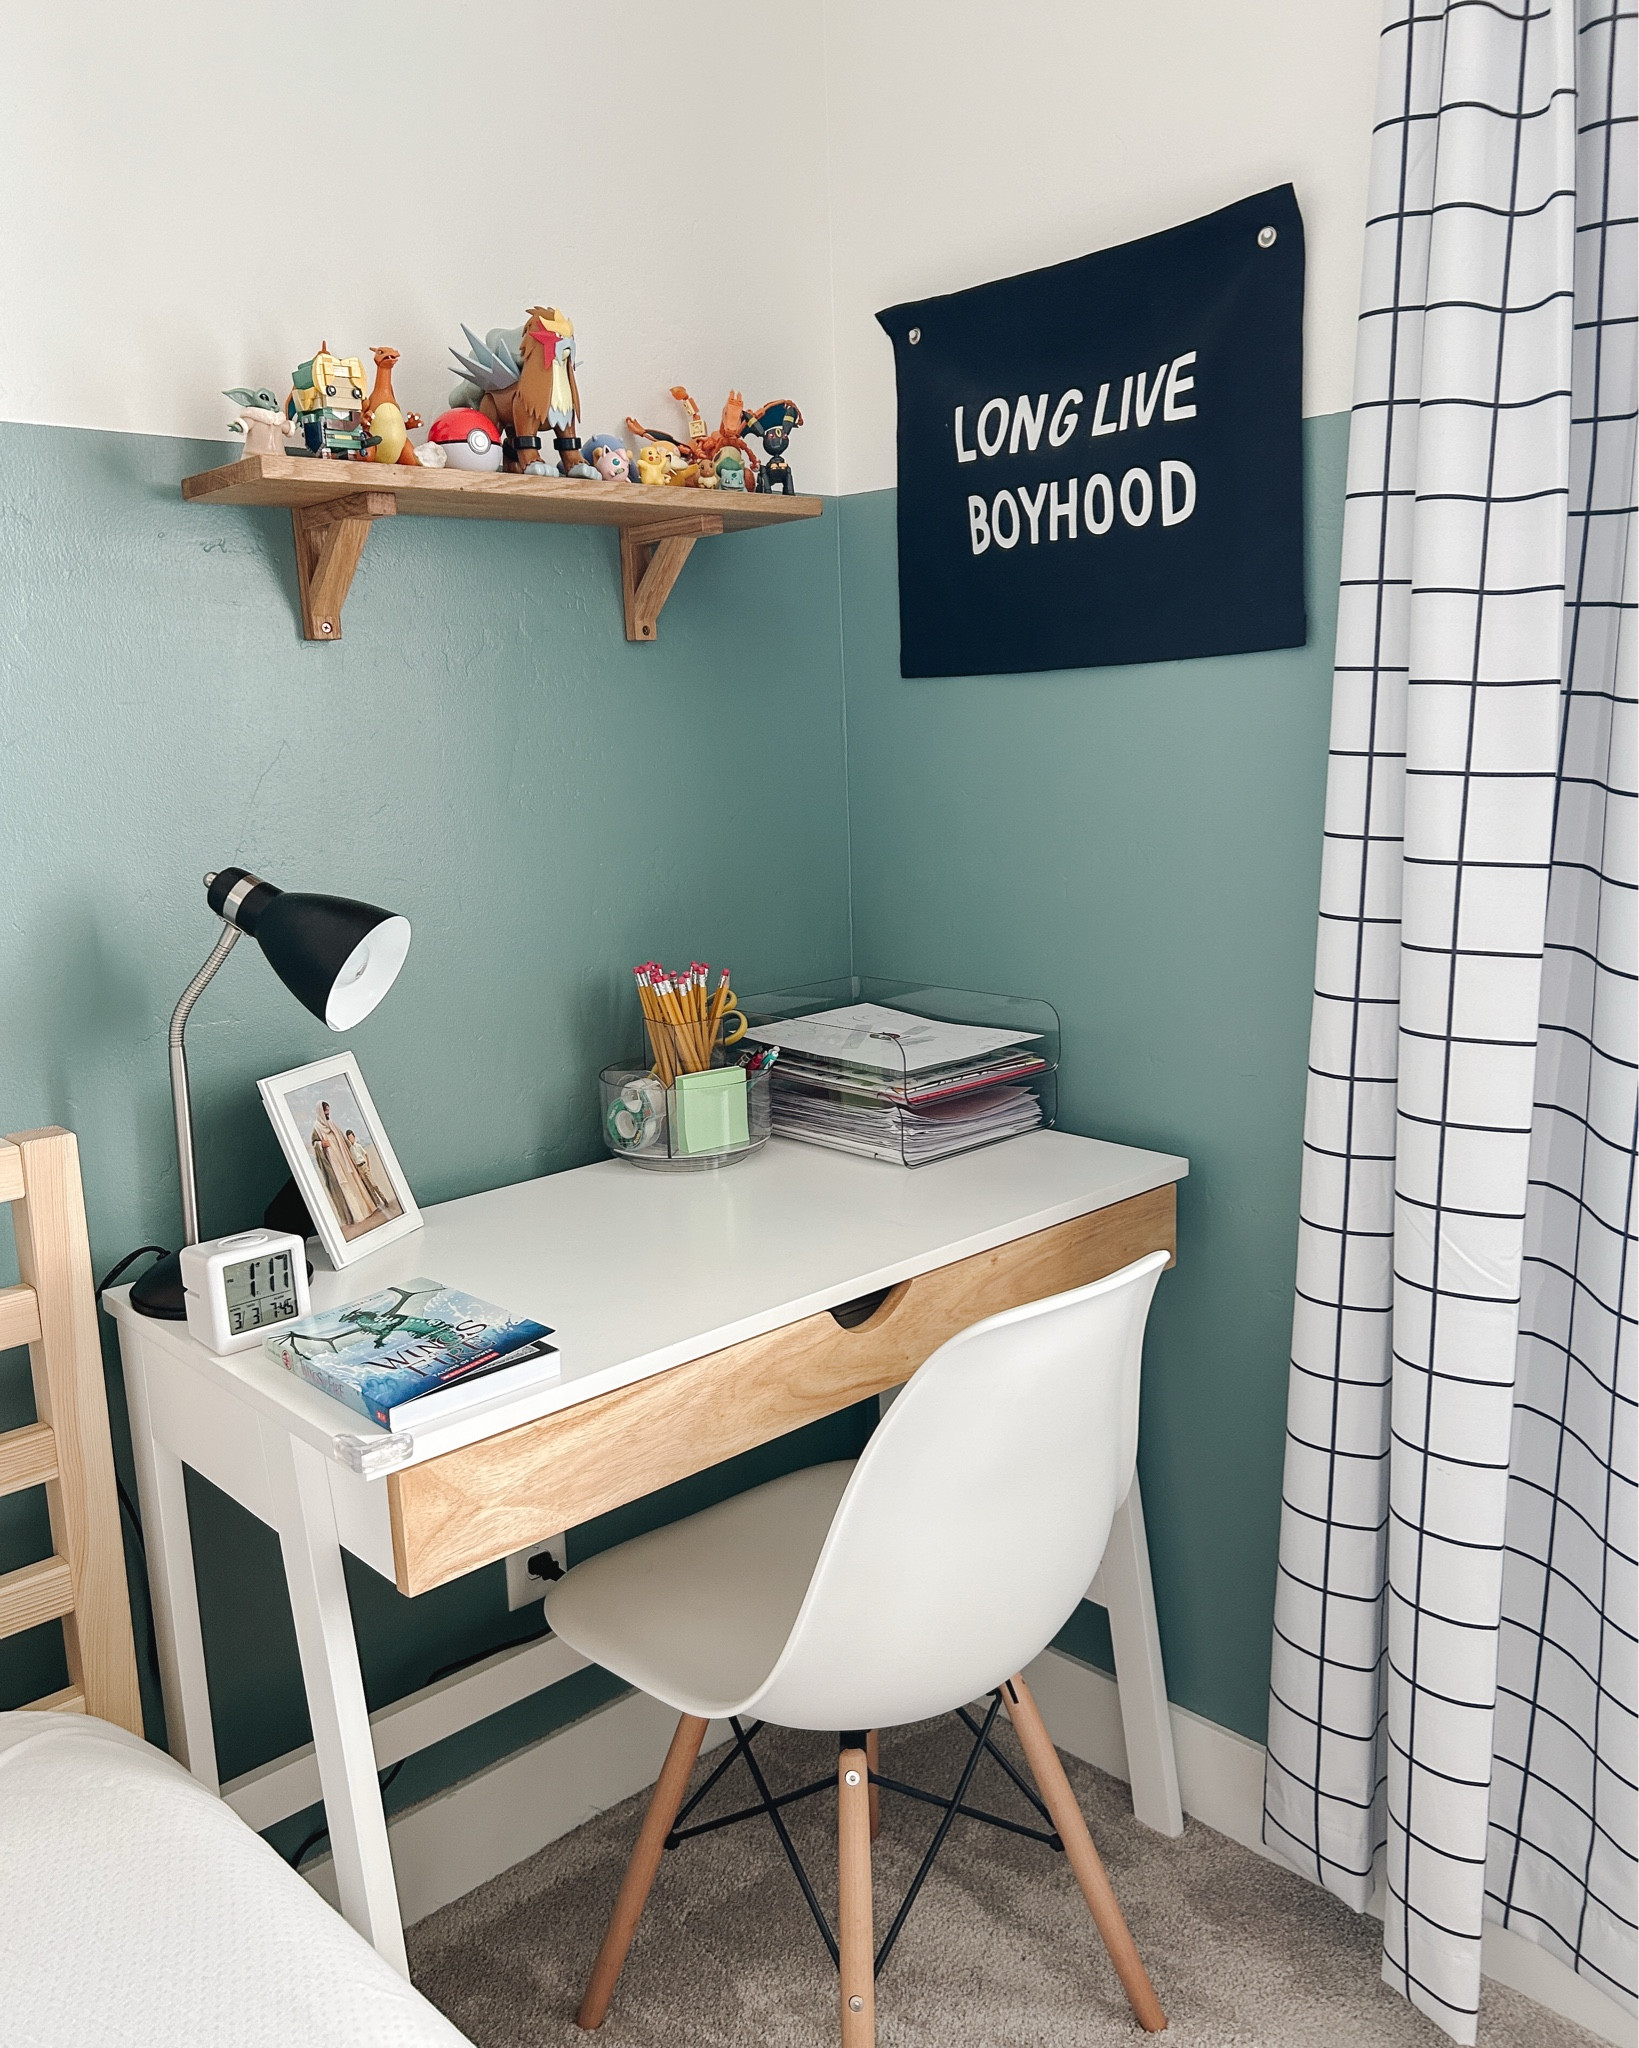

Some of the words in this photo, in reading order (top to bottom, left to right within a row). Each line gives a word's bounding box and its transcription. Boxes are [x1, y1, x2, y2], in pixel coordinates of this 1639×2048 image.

[953, 388, 1083, 463] LONG
[1092, 350, 1197, 436] LIVE
[968, 460, 1197, 555] BOYHOOD
[361, 1319, 488, 1370] WINGS
[406, 1335, 497, 1377] FIRE
